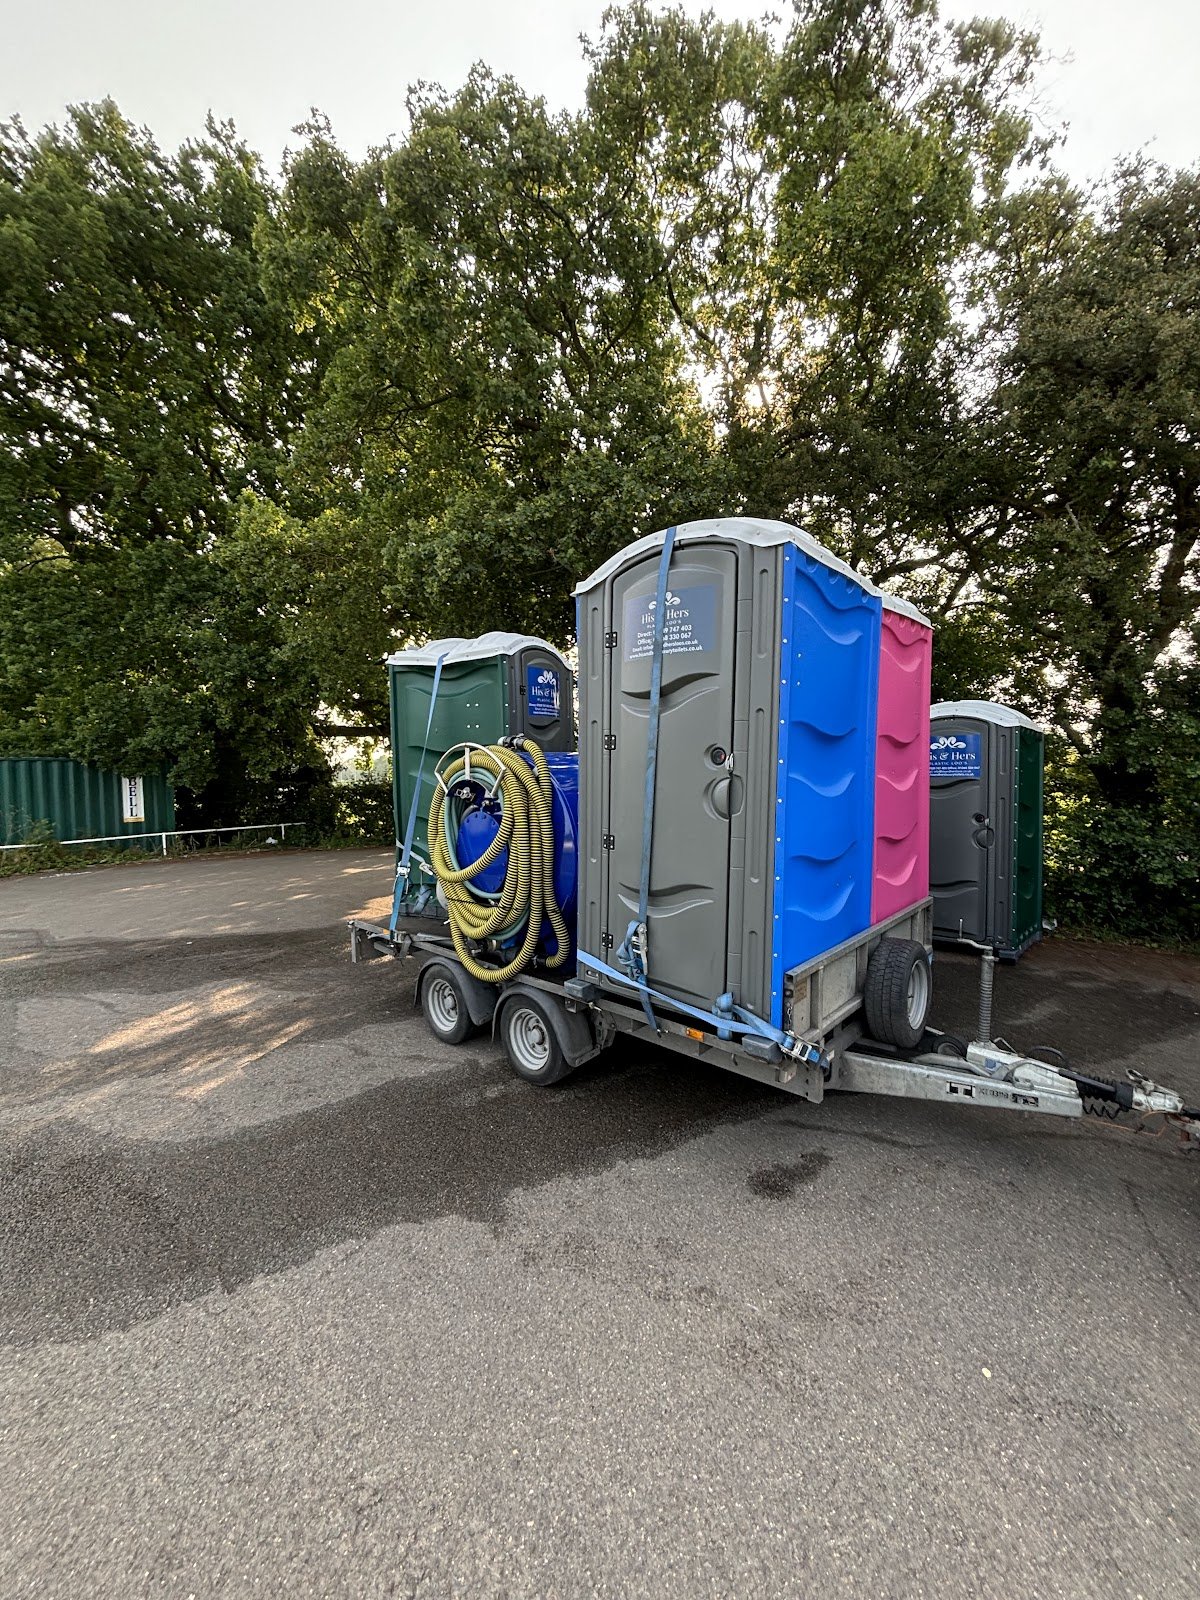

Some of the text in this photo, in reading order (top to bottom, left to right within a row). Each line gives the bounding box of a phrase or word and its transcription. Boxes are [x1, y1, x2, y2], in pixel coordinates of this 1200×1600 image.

[641, 609, 689, 624] His Hers
[532, 686, 543, 696] His
[940, 752, 949, 760] &
[951, 752, 975, 760] Hers
